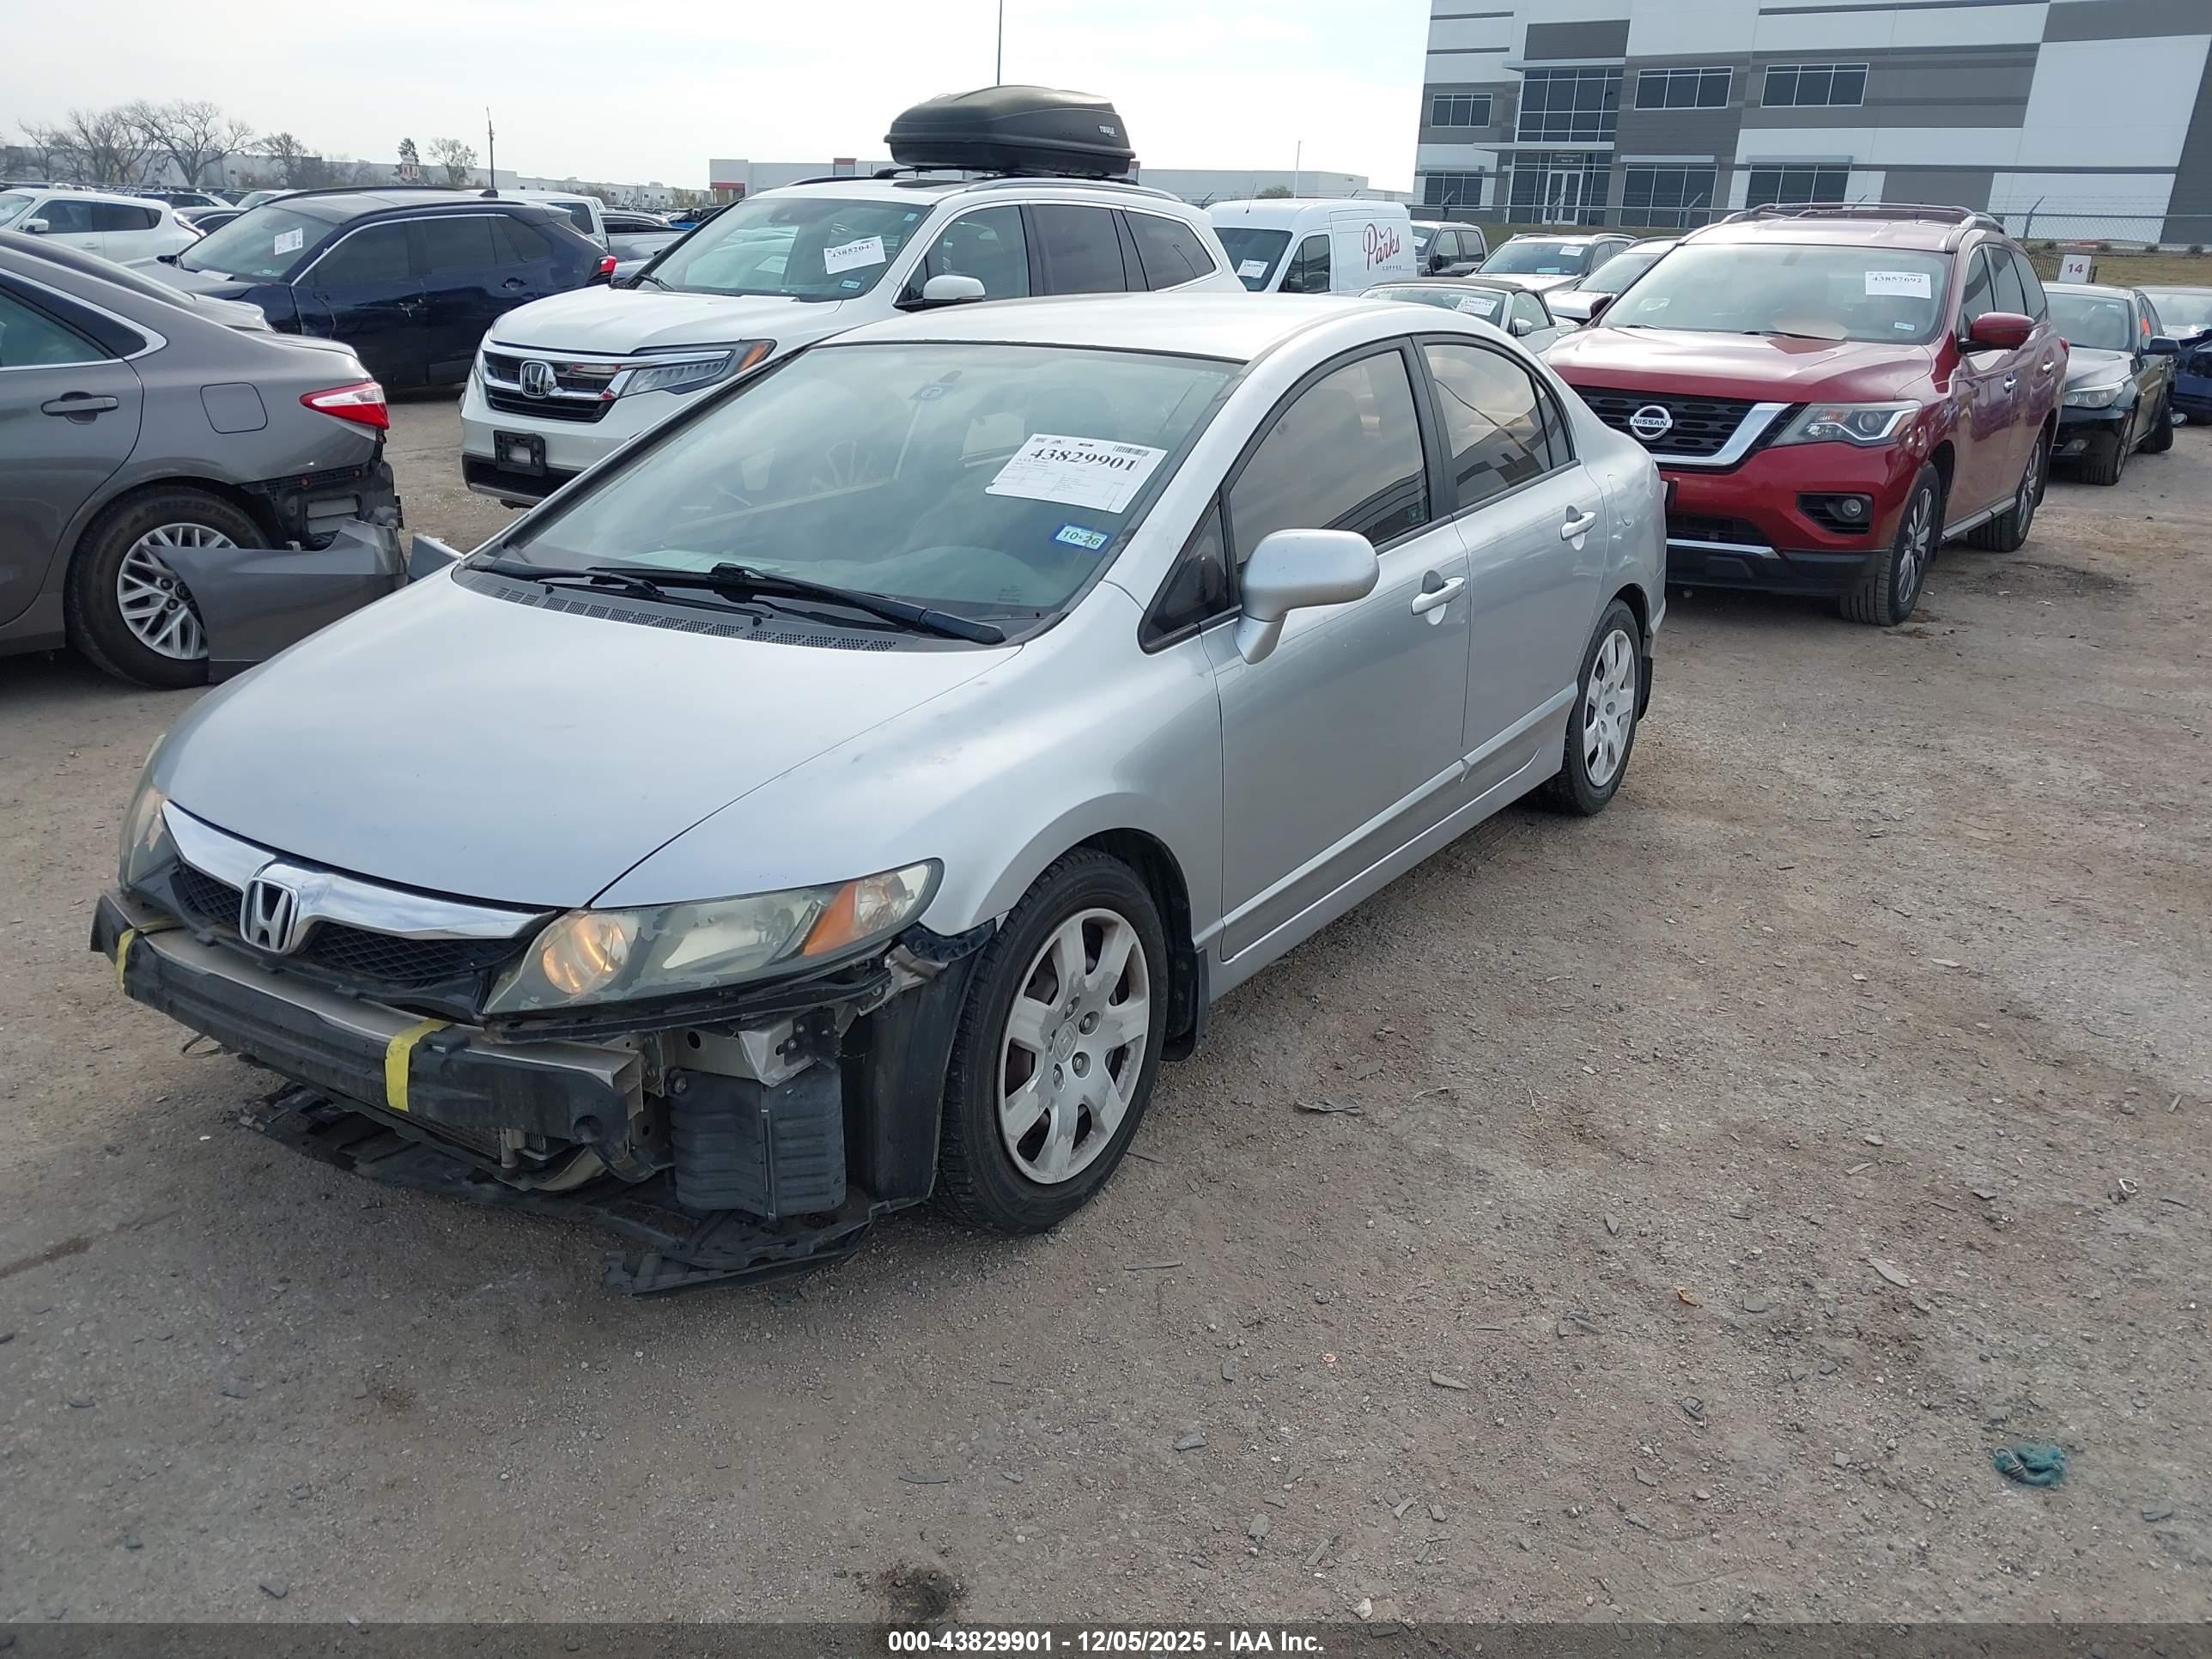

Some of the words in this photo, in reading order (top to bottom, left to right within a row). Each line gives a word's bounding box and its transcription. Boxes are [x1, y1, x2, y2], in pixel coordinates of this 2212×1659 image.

[1362, 222, 1400, 271] Parks
[2068, 263, 2083, 274] 14
[1633, 418, 1668, 427] NISSAN
[1030, 447, 1137, 471] 43829901
